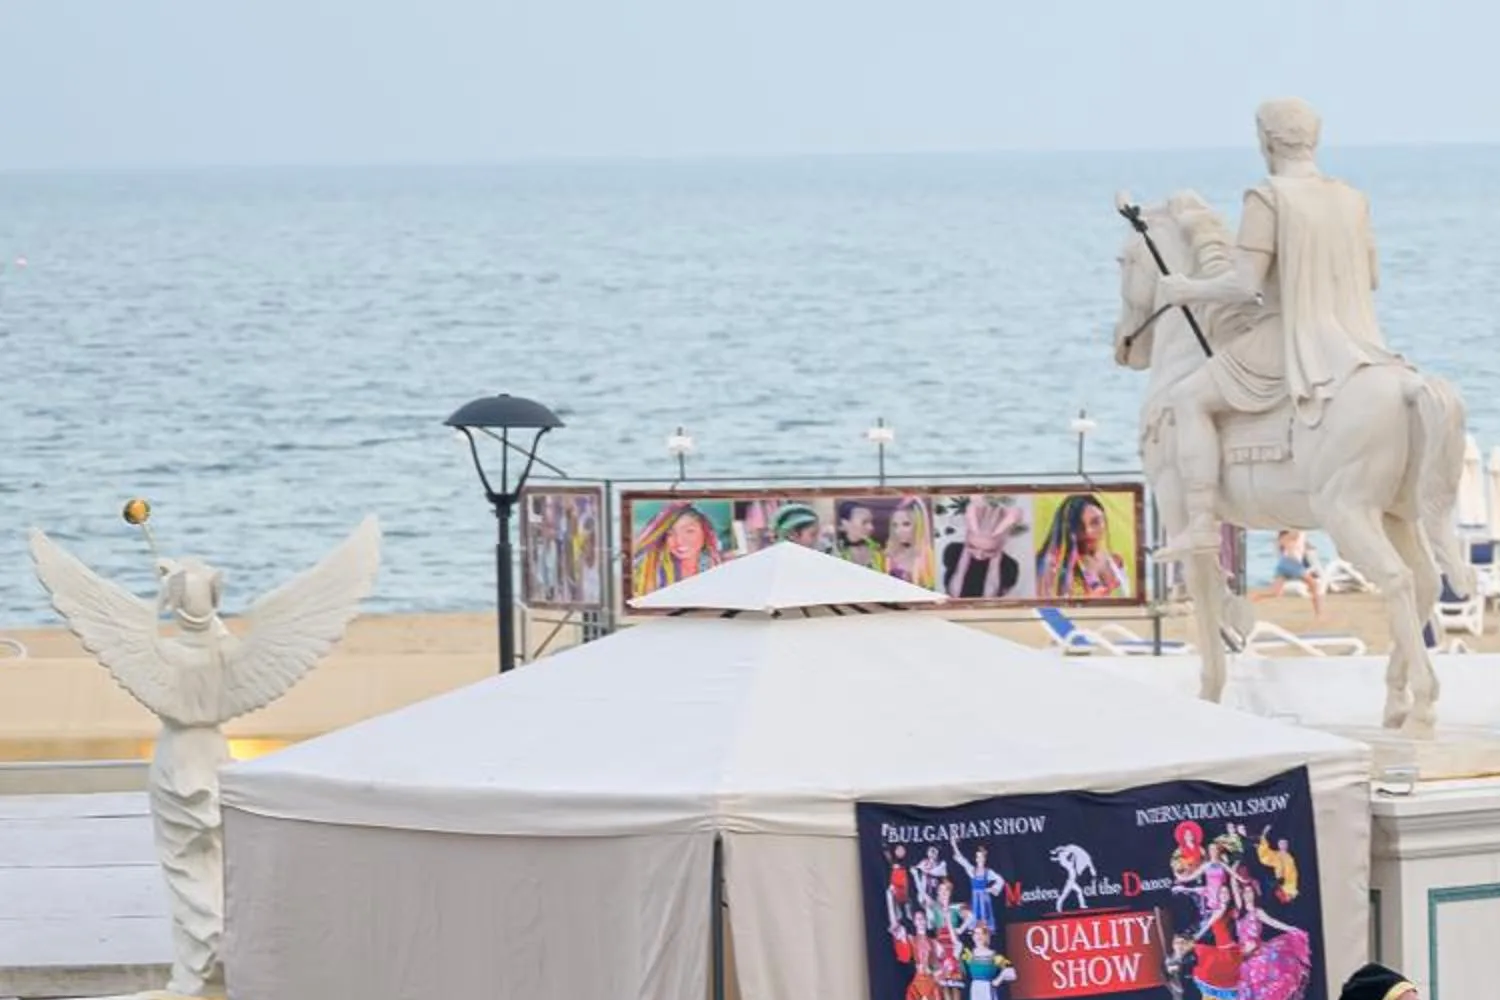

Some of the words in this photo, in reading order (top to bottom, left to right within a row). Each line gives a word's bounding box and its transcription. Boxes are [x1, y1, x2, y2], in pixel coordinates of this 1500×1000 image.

[994, 815, 1047, 836] SHOW
[1099, 876, 1122, 895] the
[1122, 871, 1173, 898] Dance
[1025, 915, 1155, 961] QUALITY
[1051, 952, 1143, 991] SHOW
